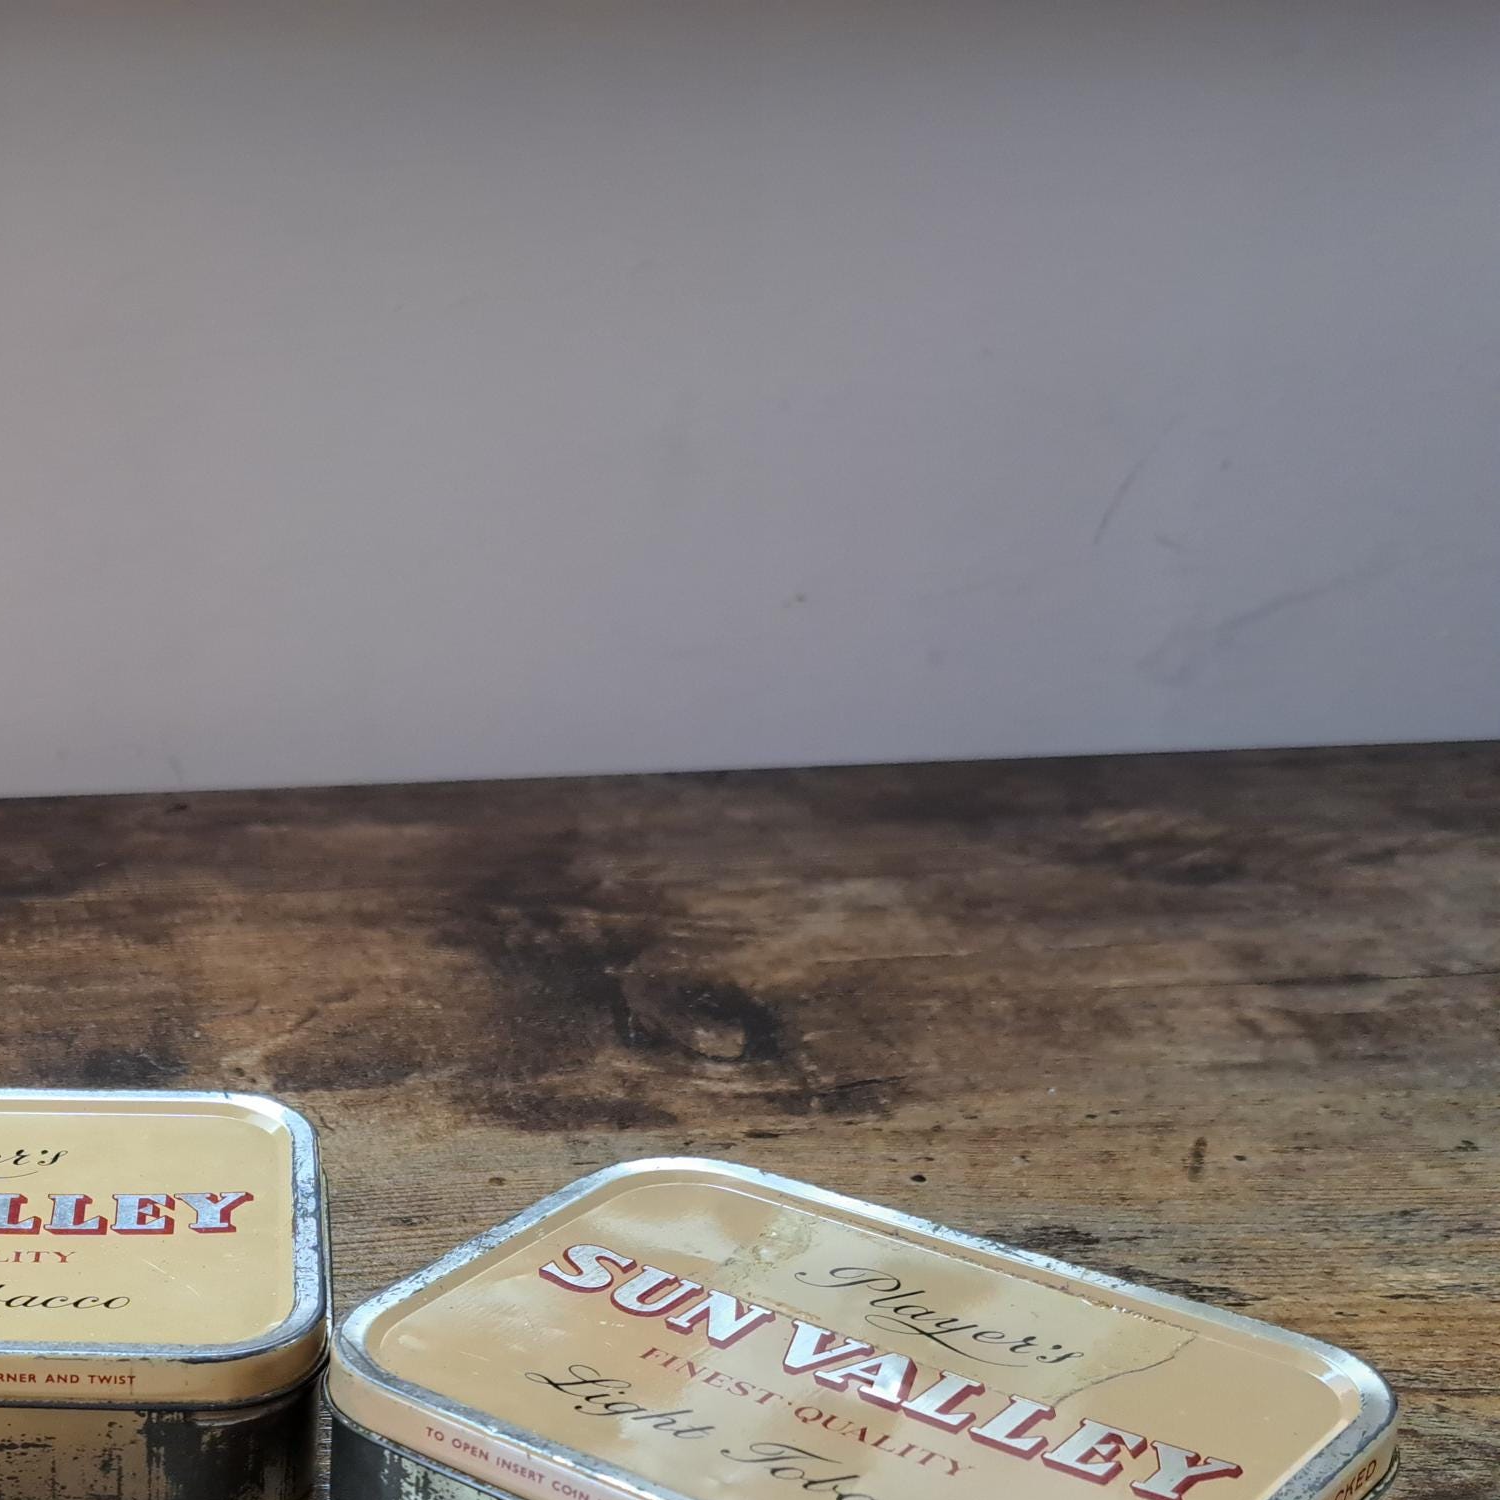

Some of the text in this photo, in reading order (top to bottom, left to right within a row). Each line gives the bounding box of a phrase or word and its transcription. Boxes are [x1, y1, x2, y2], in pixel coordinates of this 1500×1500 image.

[538, 1243, 777, 1350] SUN
[794, 1266, 1085, 1368] Player's
[45, 1373, 80, 1384] AND
[88, 1374, 136, 1385] TWIST
[524, 1364, 716, 1440] Light
[638, 1346, 977, 1478] FINEST QUALITY
[425, 1426, 445, 1443] TO
[451, 1438, 489, 1462] OPEN
[496, 1455, 546, 1485] INSERT
